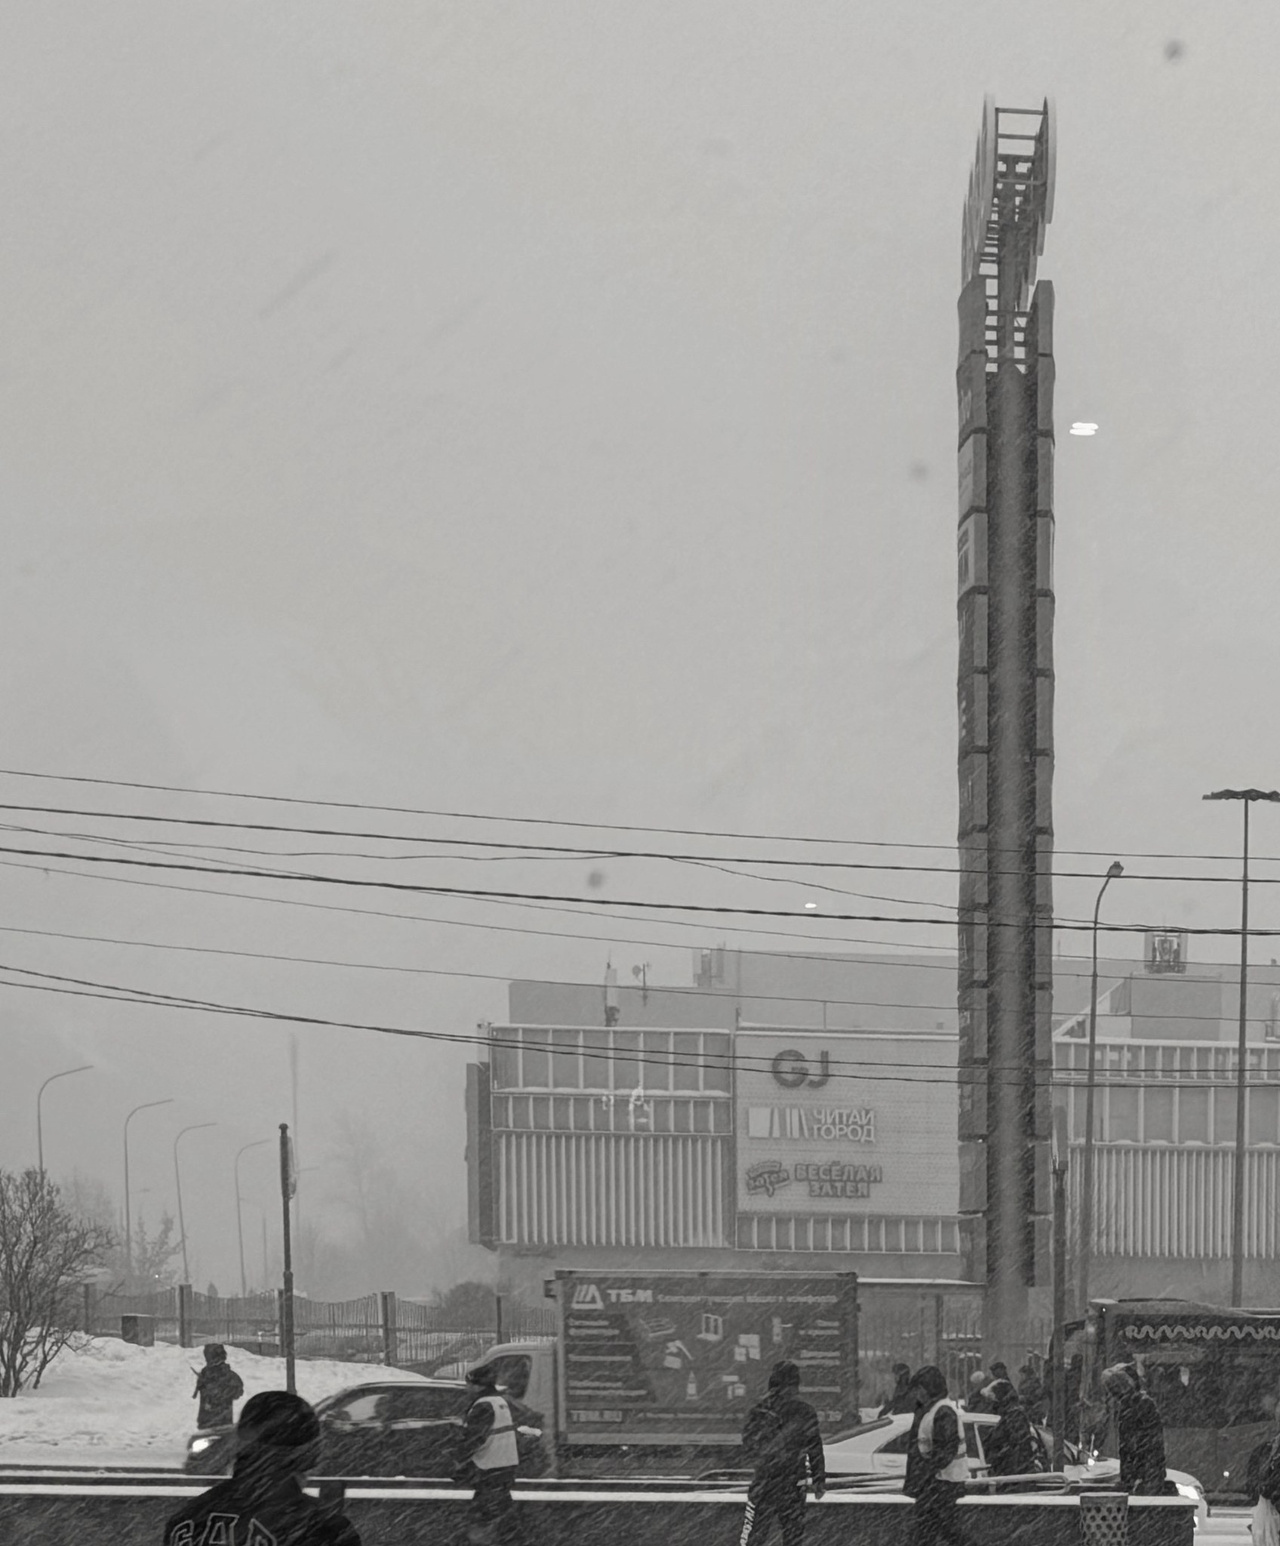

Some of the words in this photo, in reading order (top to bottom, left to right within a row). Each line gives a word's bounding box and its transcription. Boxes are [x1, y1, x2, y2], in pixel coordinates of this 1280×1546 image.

[772, 1049, 829, 1088] GJ
[813, 1107, 875, 1125] ЧИТАЙ
[813, 1124, 876, 1143] ГОРОД
[809, 1182, 870, 1198] ЗАТЕЯ
